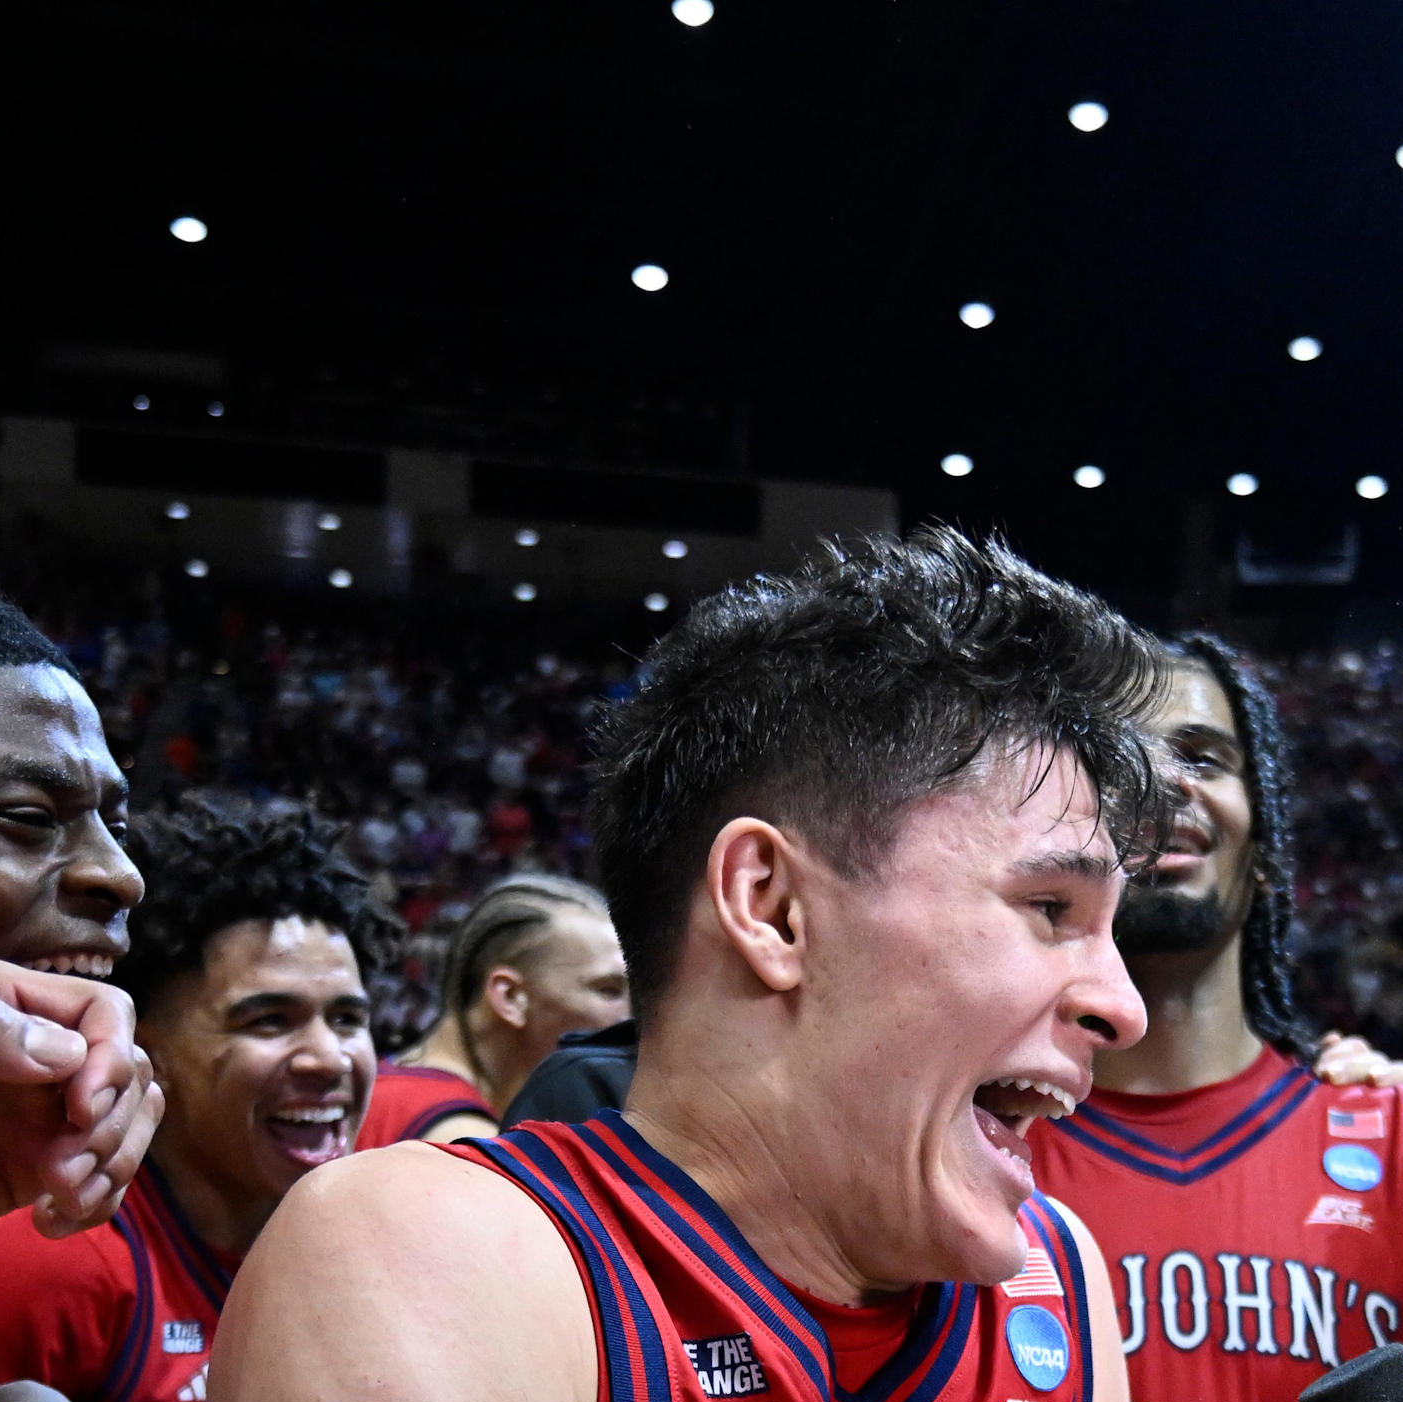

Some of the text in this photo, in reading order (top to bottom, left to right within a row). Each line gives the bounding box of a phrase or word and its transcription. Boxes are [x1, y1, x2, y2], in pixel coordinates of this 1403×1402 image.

[682, 1337, 752, 1369] E THE
[1016, 1343, 1065, 1371] NCAA
[698, 1363, 766, 1396] ANGE
